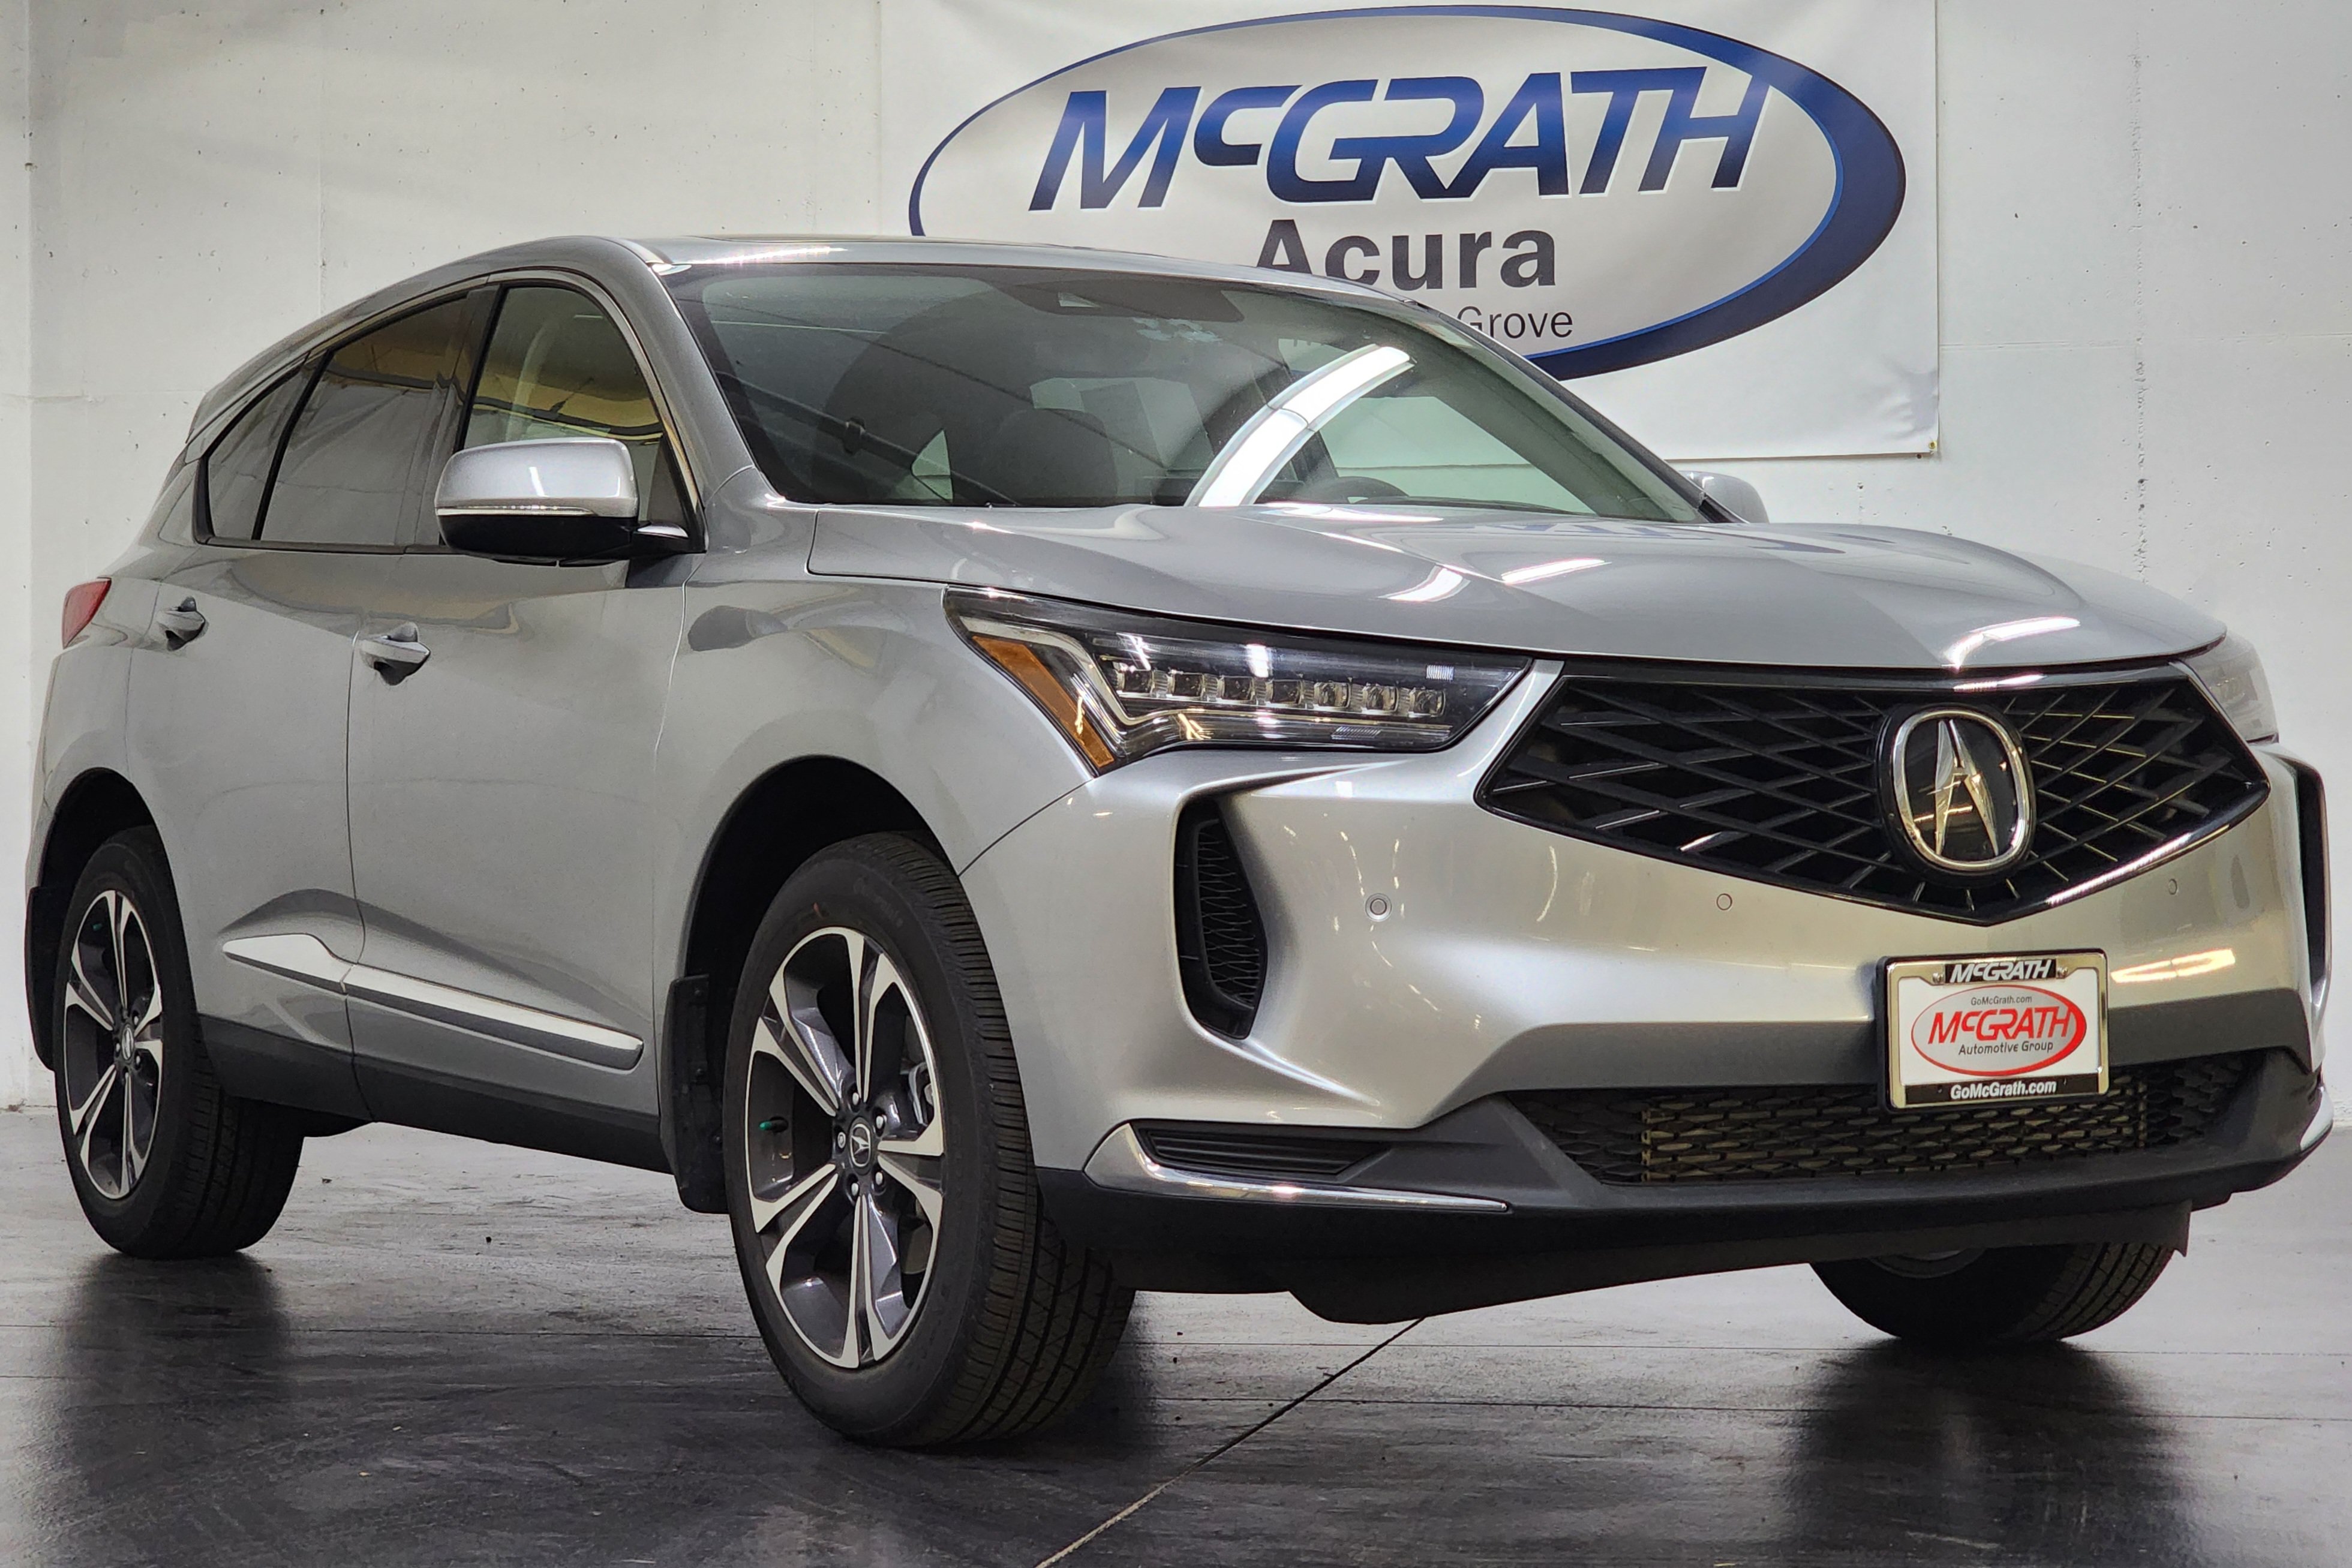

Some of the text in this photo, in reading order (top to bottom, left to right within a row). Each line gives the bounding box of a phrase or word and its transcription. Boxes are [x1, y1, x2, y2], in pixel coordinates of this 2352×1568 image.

[1029, 66, 1768, 211] McGRATH
[1257, 218, 1556, 290] Acura
[1456, 306, 1573, 339] Grove
[1950, 960, 2051, 983] McGRATH
[1970, 995, 2032, 1006] GoMcGrath.com
[1928, 1006, 2072, 1044] McGRATH
[1959, 1041, 2054, 1056] Automotive Group
[1951, 1080, 2056, 1100] GoMcGrath.com
